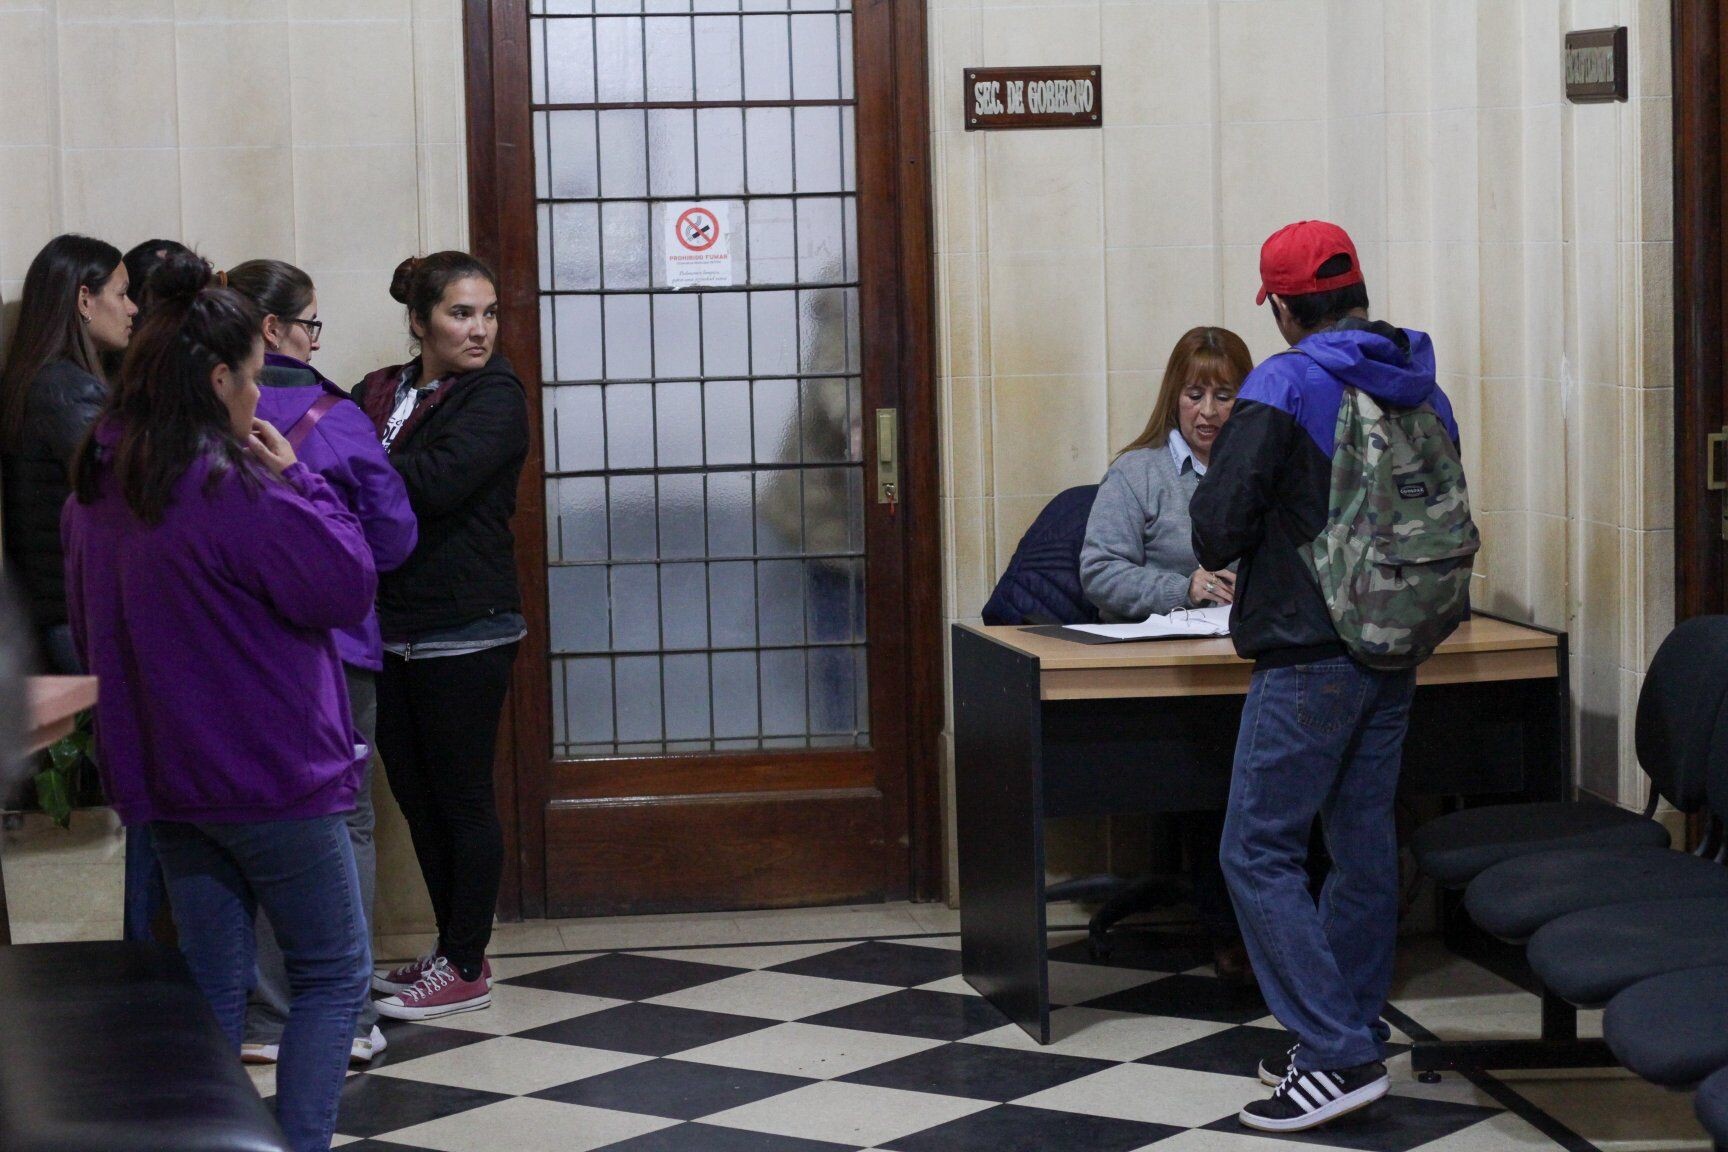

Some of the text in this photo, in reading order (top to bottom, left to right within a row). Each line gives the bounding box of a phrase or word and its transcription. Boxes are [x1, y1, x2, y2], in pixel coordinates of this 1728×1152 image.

[974, 79, 1094, 115] SEC. DE GOBIERNO
